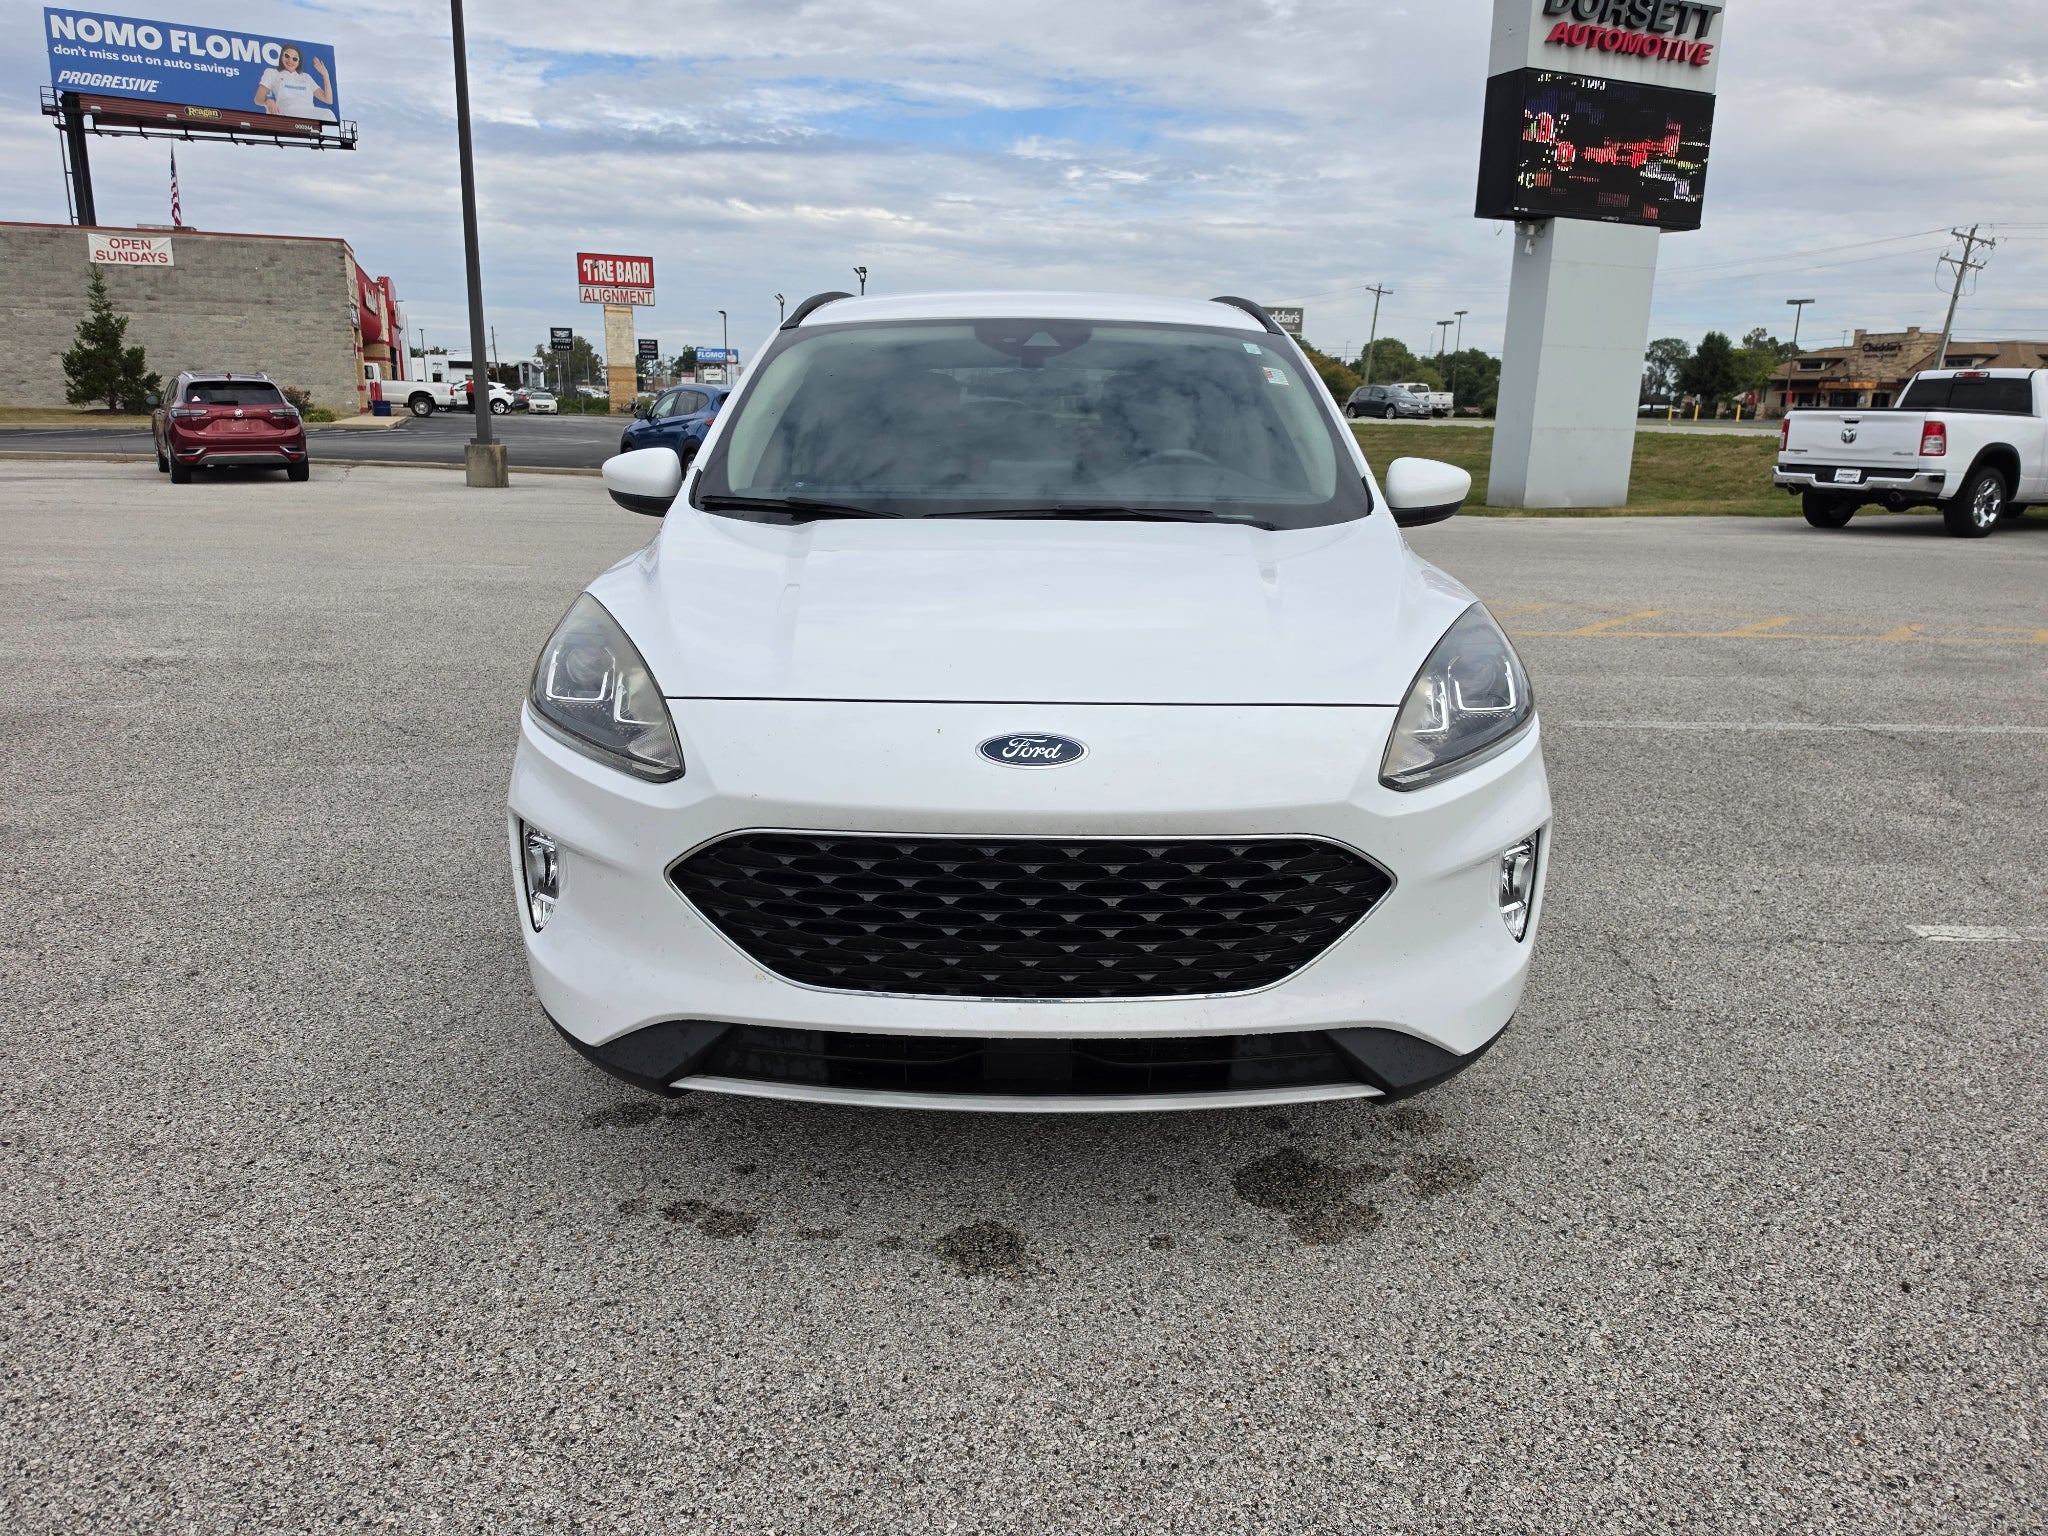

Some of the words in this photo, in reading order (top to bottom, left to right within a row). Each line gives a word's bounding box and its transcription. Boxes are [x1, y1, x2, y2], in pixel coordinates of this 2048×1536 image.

[50, 14, 163, 51] NOMO
[169, 29, 283, 67] FLOMO
[1544, 21, 1714, 66] AUTOMOTIVE
[53, 44, 87, 57] don't
[89, 49, 120, 61] miss
[121, 54, 143, 64] out
[145, 56, 162, 66] on
[163, 59, 192, 70] auto
[194, 63, 240, 77] savings
[58, 70, 160, 93] PROGRESSIVE
[188, 107, 219, 119] Reagan
[109, 238, 152, 250] OPEN
[96, 250, 168, 263] SUNDAYS
[616, 261, 650, 284] BARN
[583, 288, 652, 304] ALIGNMENT
[1270, 311, 1300, 323] ddar's
[1002, 738, 1062, 759] Ford
